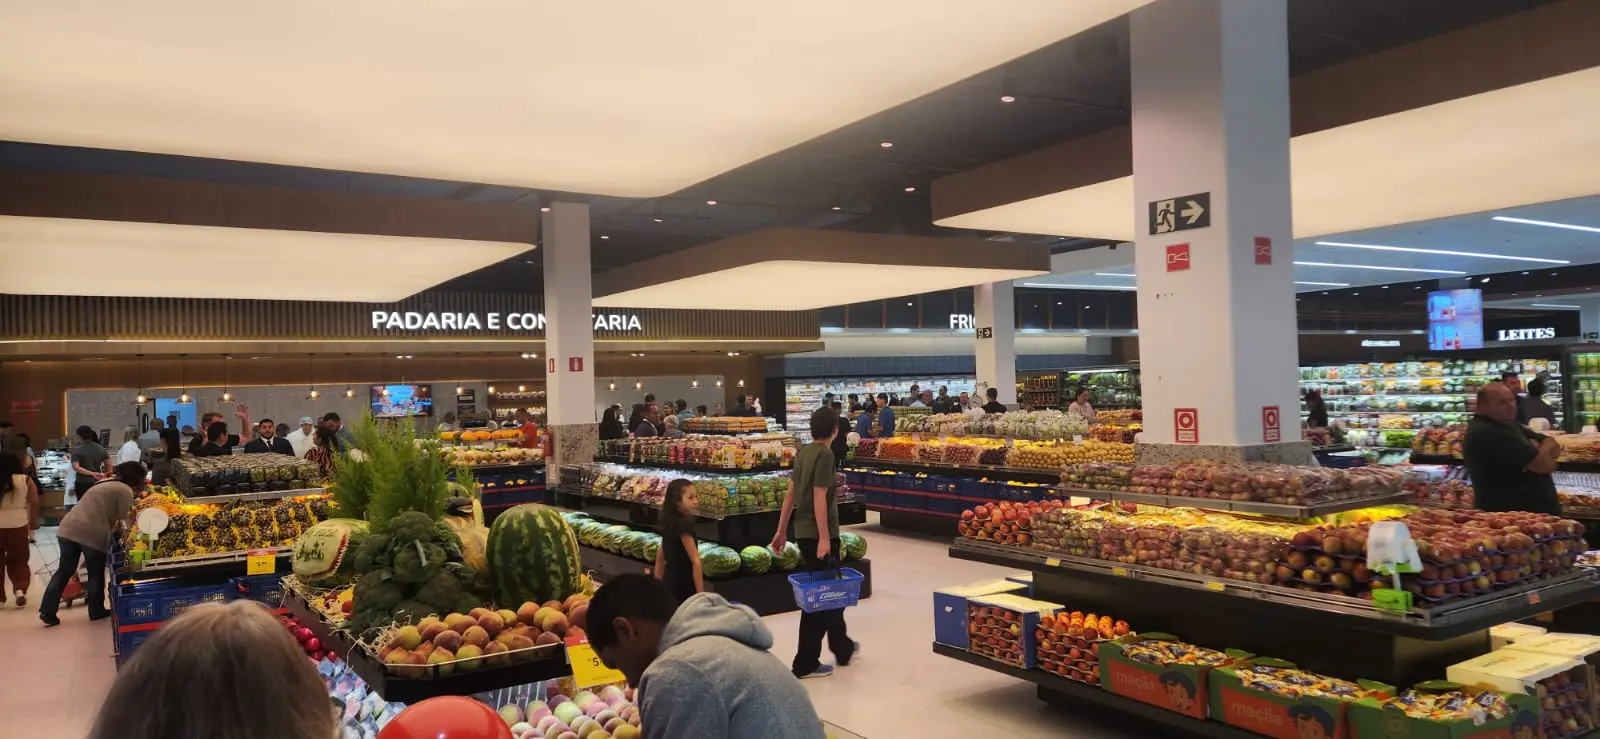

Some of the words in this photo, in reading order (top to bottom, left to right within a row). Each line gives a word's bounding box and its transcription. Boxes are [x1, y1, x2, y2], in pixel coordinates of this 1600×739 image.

[371, 311, 481, 330] PADARIA
[487, 313, 500, 330] E
[506, 313, 642, 331] CONARIA
[1498, 327, 1556, 341] LEITES
